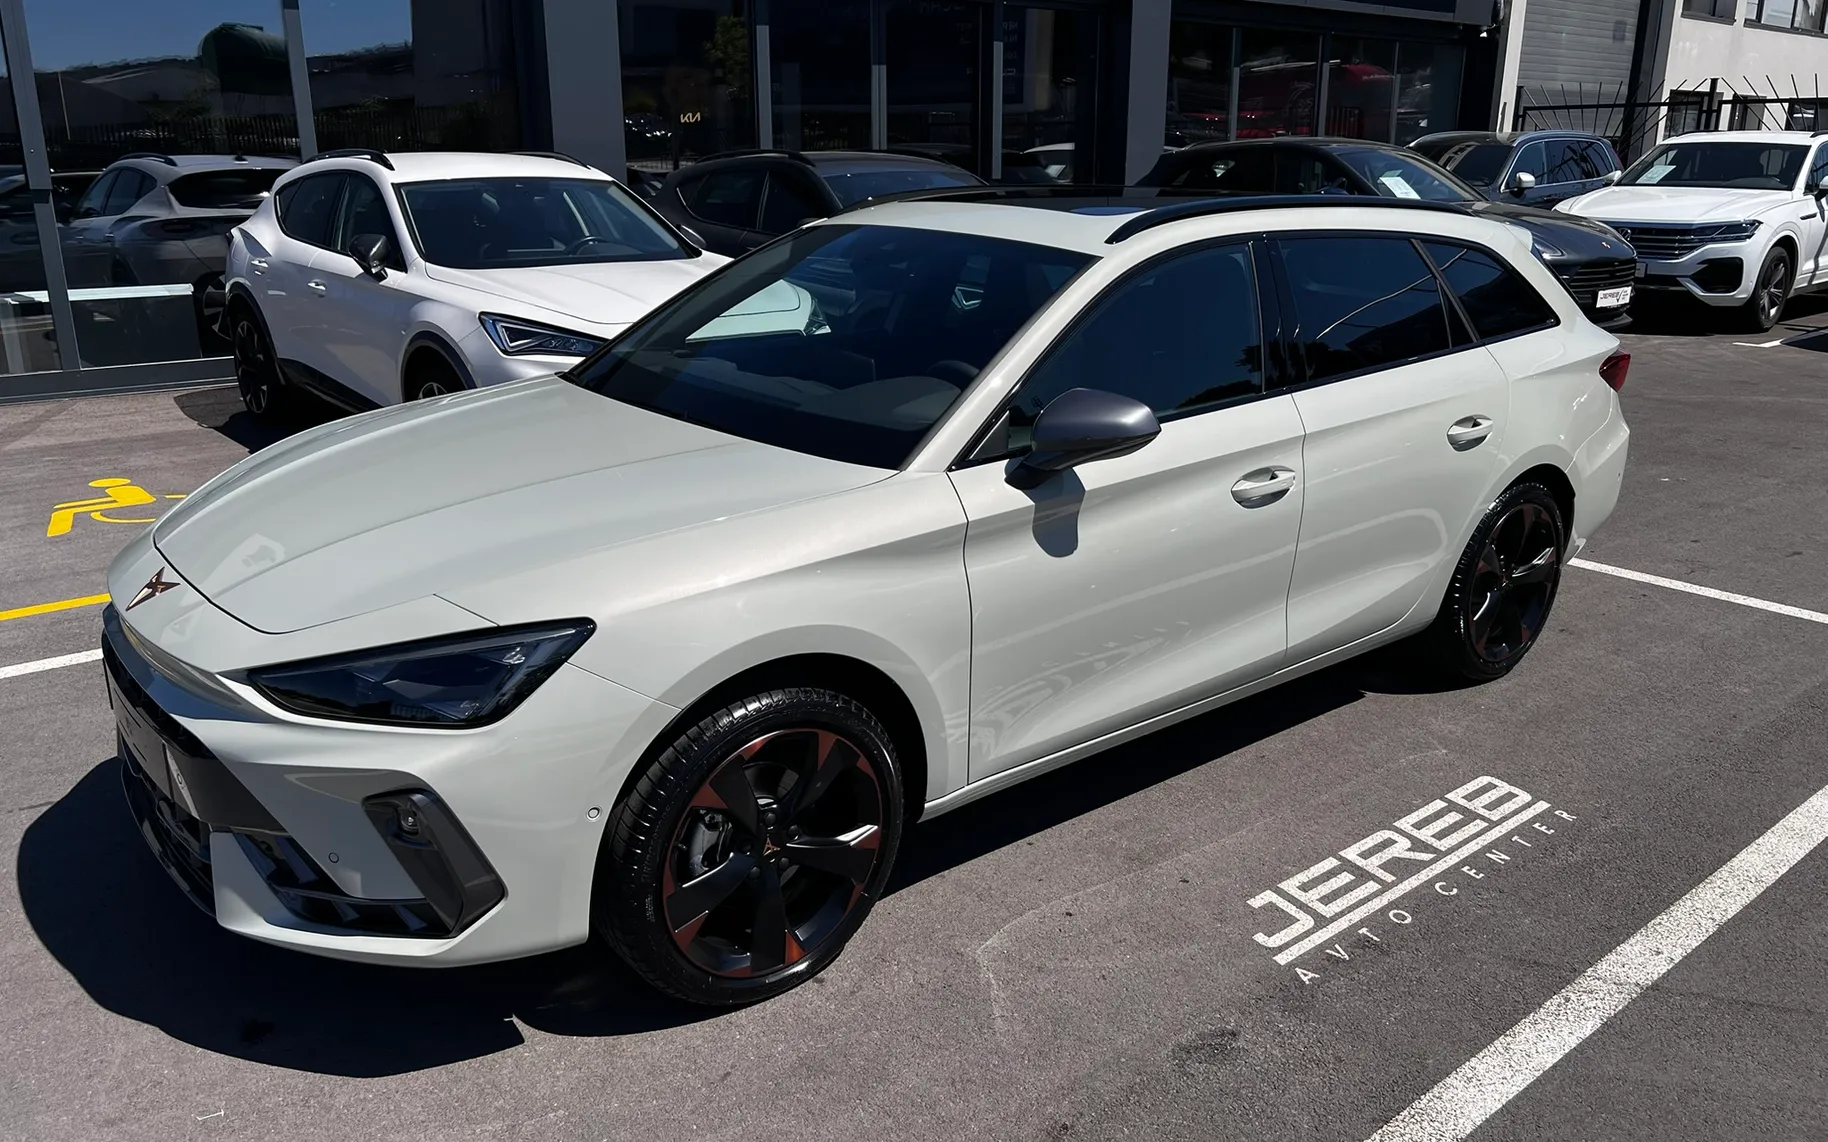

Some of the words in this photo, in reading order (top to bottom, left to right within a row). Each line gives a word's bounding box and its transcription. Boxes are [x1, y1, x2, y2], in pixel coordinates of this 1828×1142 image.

[1246, 775, 1533, 948] JEREB
[1294, 908, 1413, 986] AVTO
[1434, 809, 1578, 897] CENTER
